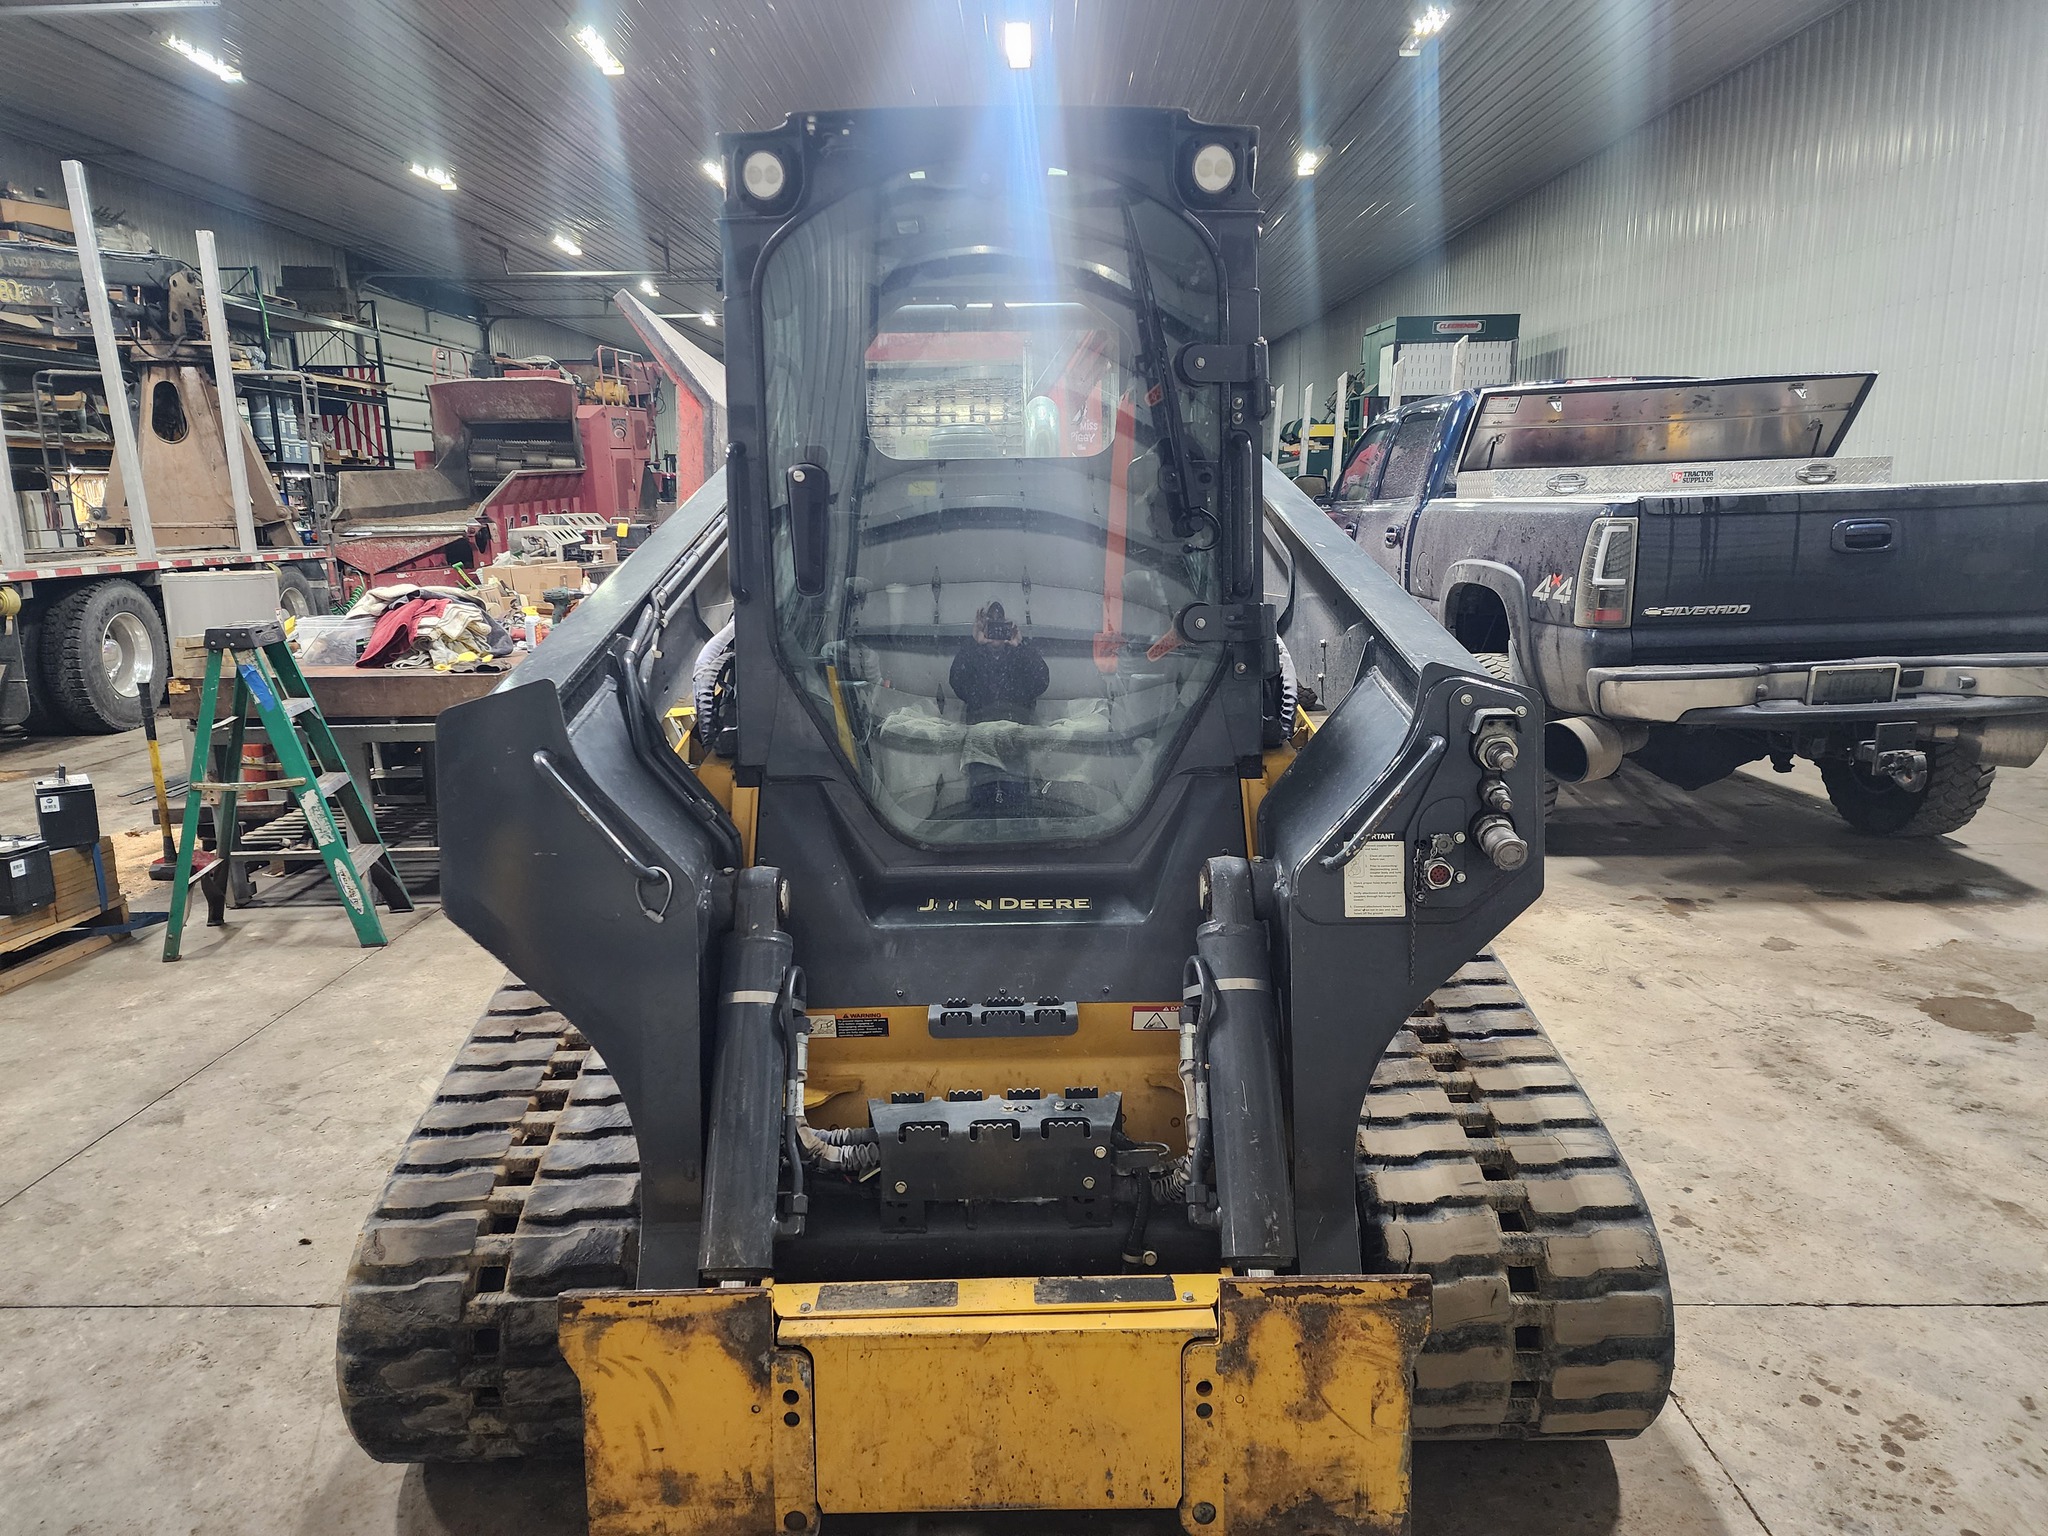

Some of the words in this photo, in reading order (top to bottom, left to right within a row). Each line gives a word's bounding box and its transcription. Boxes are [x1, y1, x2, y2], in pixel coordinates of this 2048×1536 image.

[1661, 604, 1752, 617] SILVERADO
[918, 898, 992, 911] JN
[1000, 897, 1091, 910] DEERE
